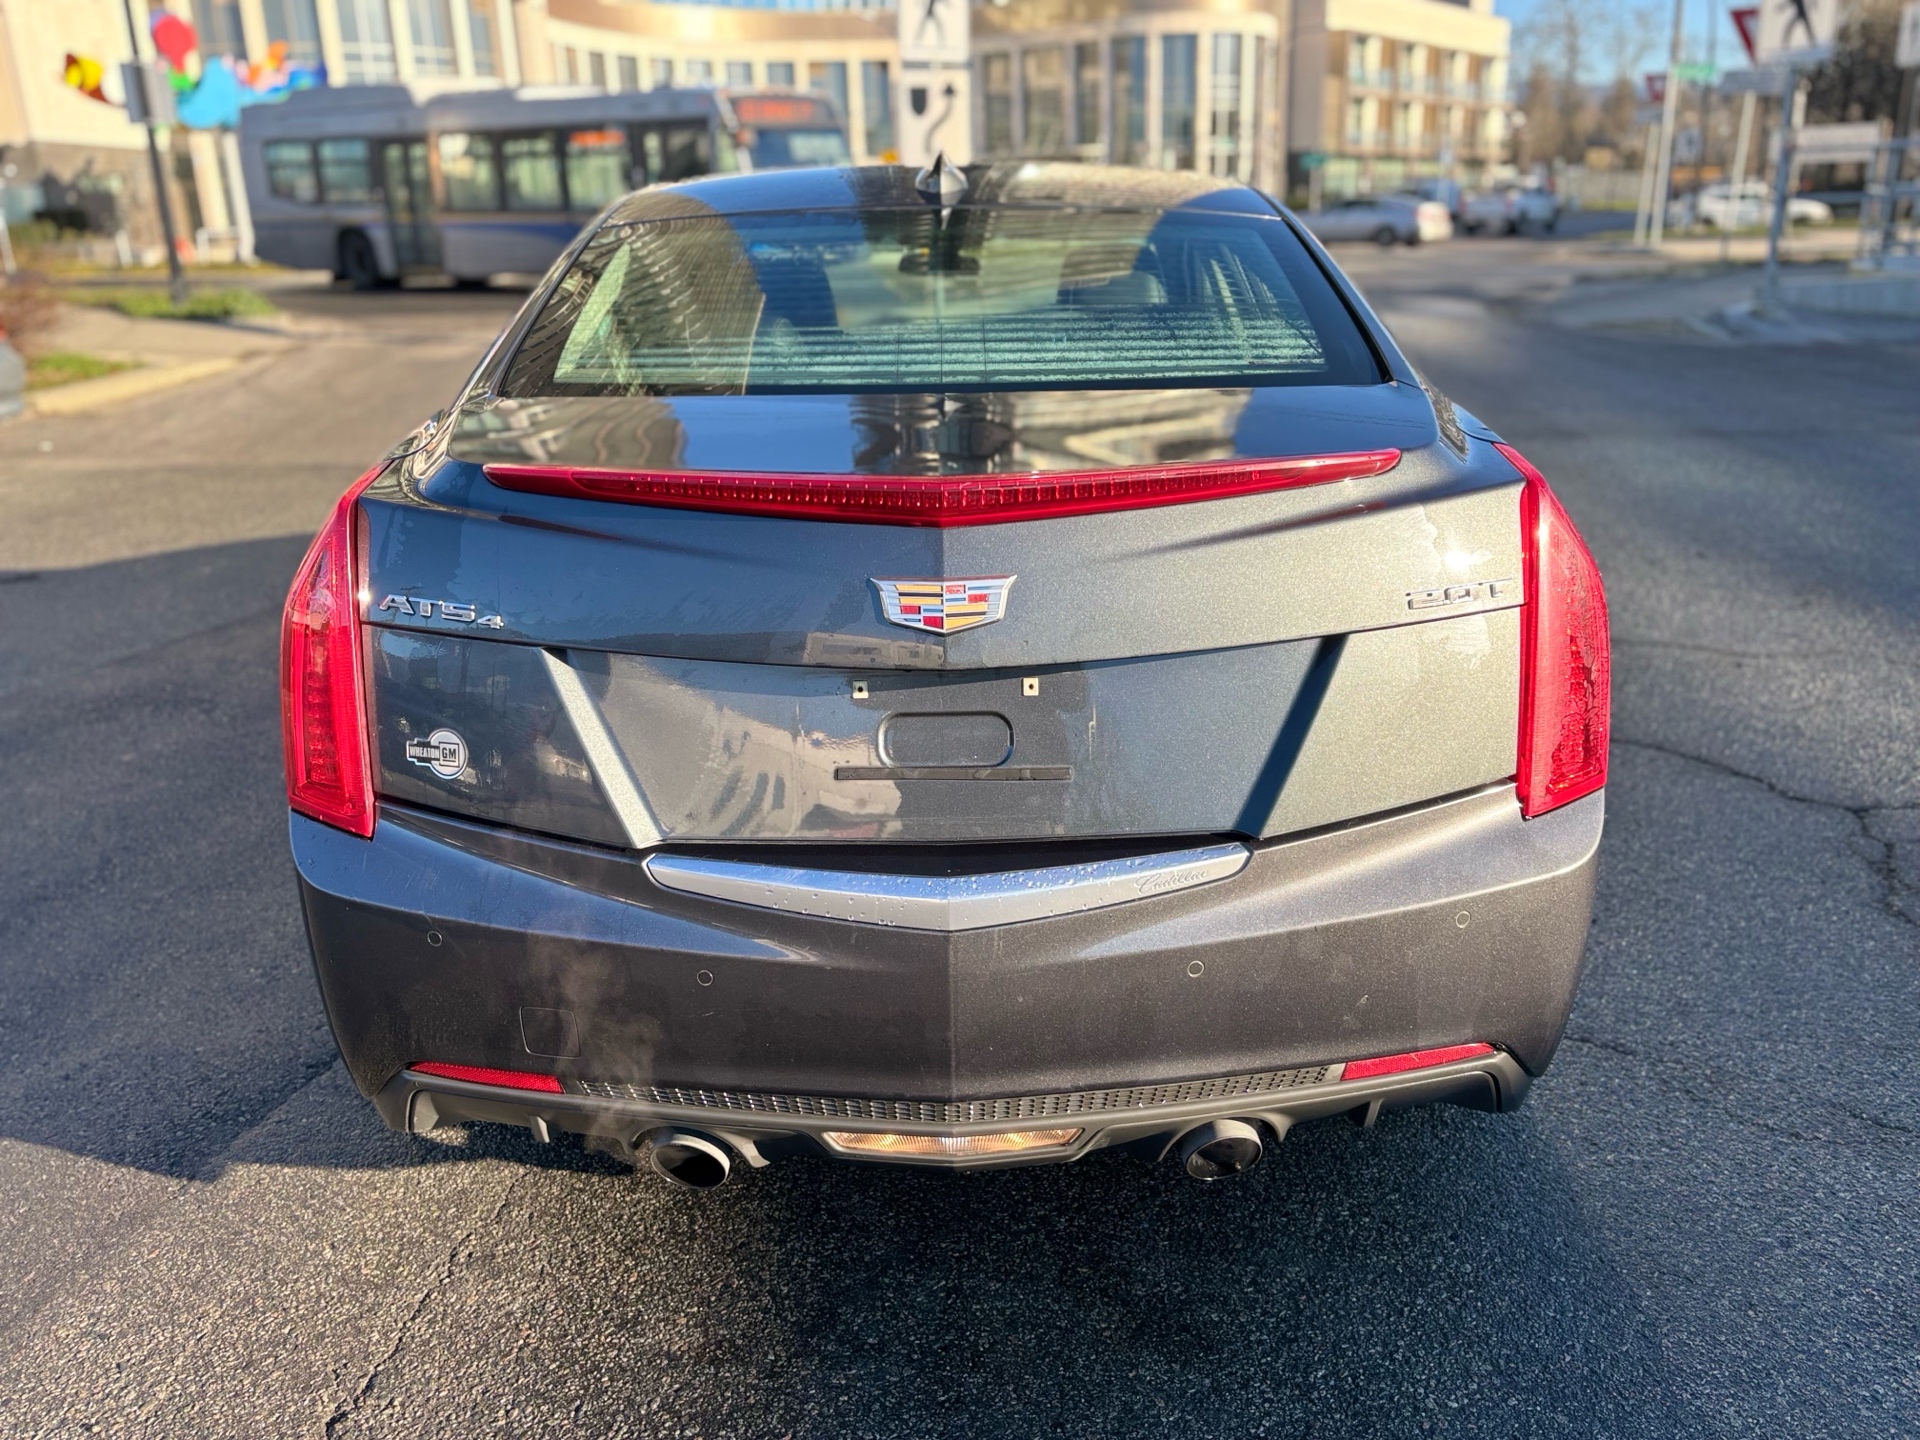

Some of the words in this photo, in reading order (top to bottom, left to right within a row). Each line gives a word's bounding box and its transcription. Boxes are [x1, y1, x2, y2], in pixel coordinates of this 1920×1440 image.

[408, 745, 440, 760] WHEATON
[441, 746, 457, 761] GM
[1133, 870, 1209, 895] Cadillac
